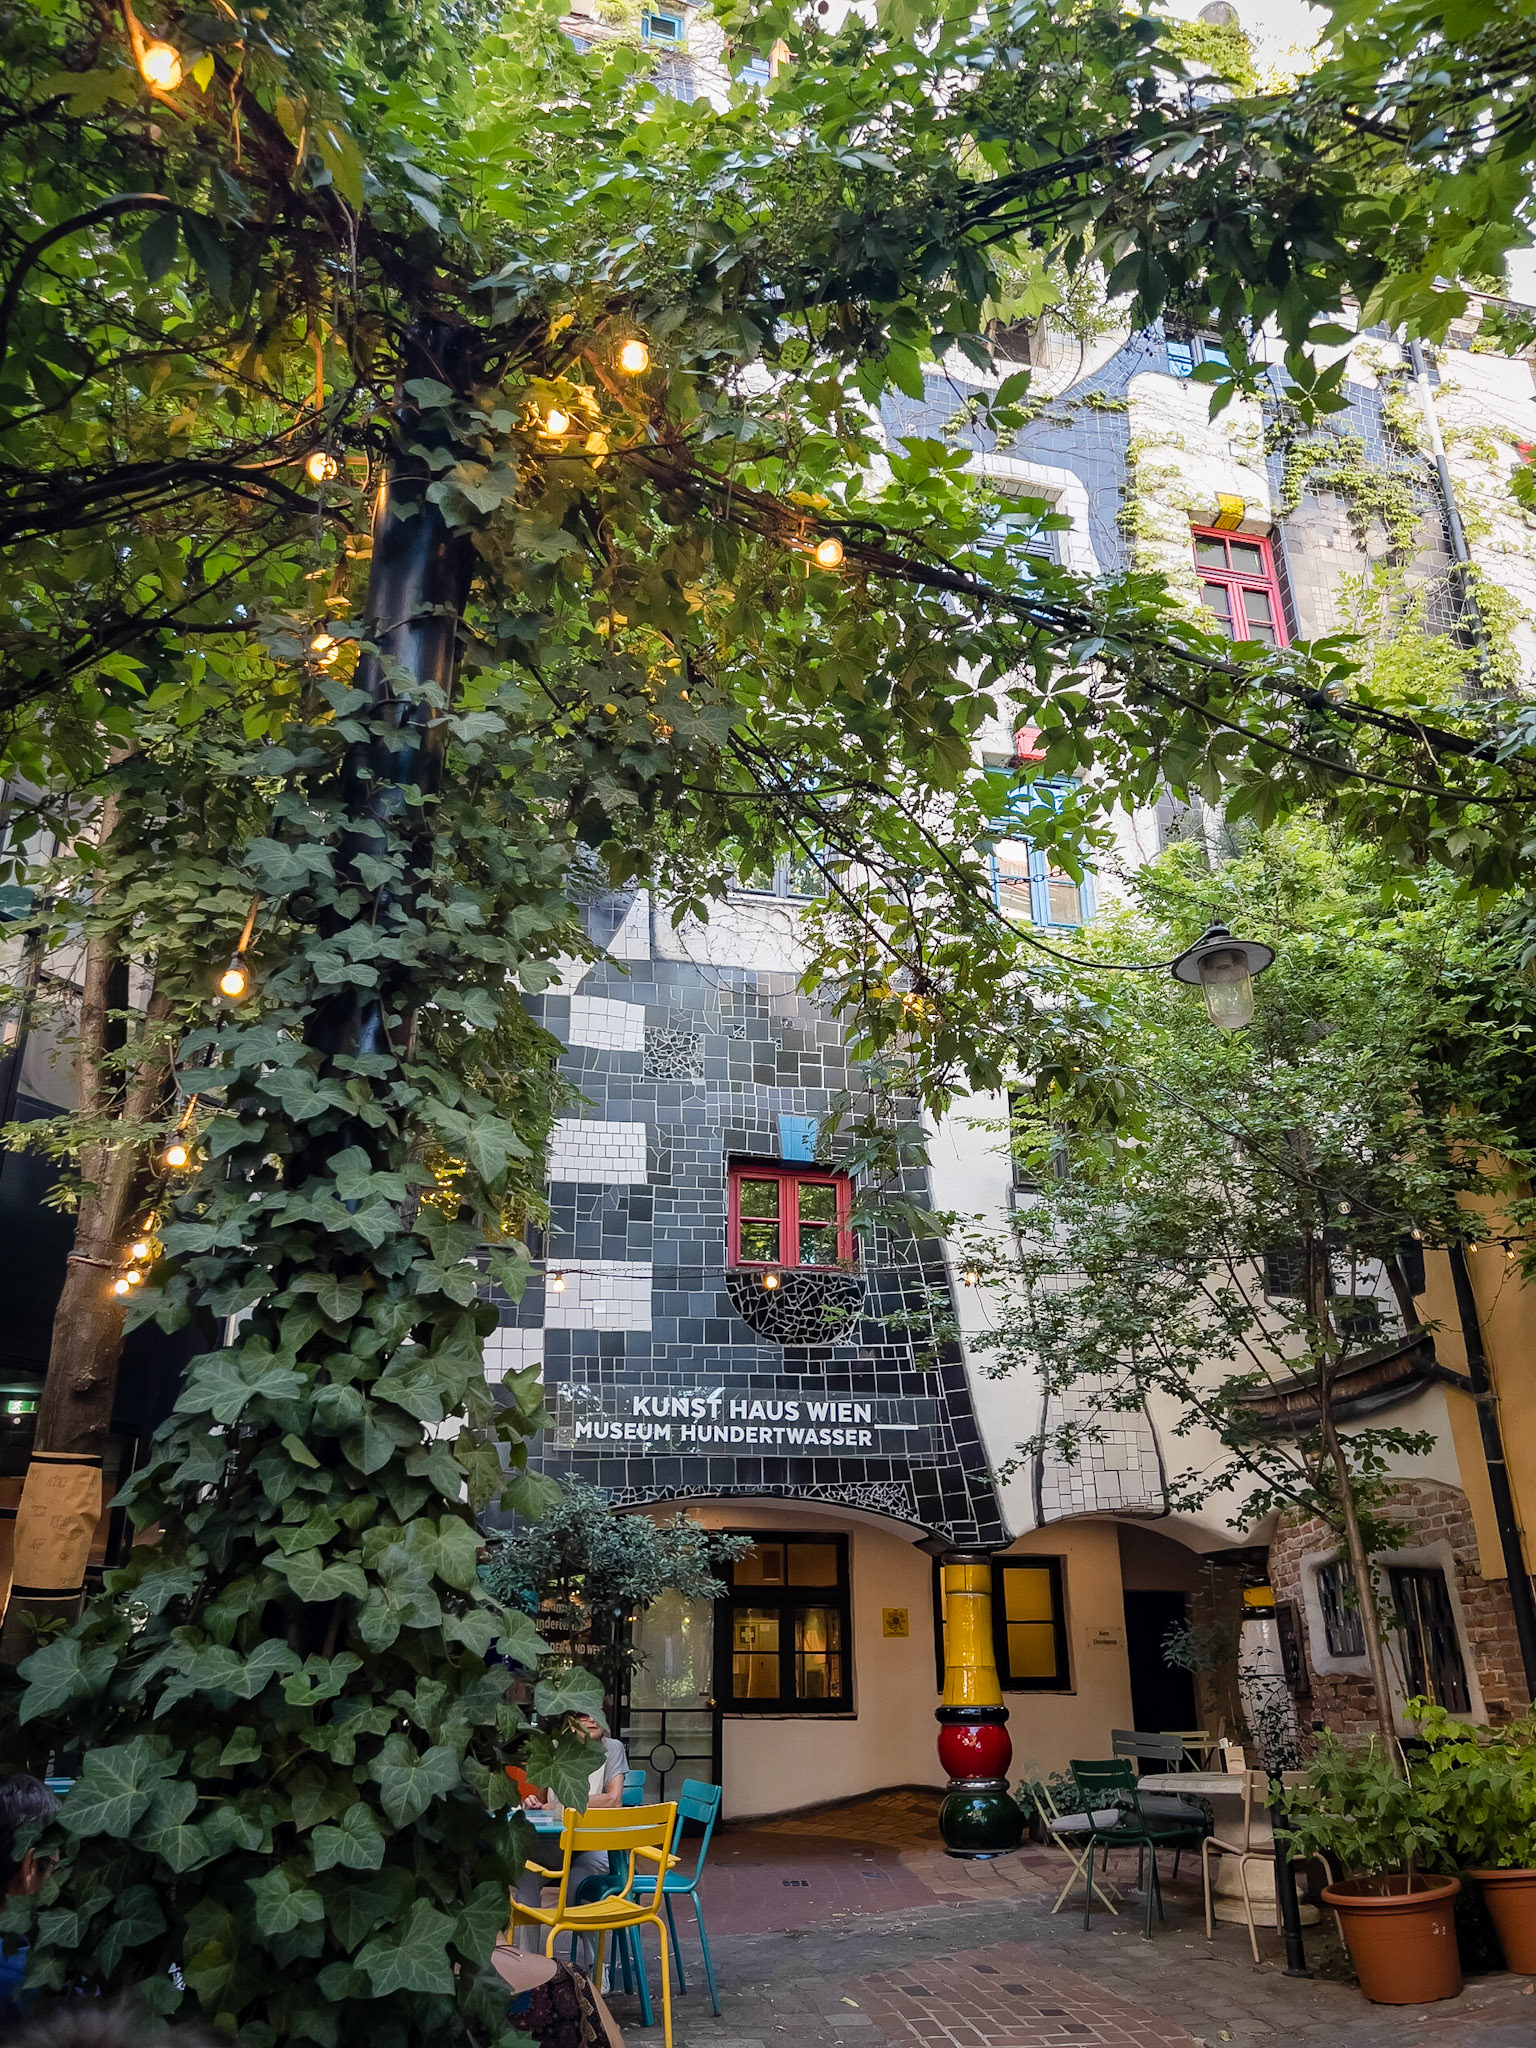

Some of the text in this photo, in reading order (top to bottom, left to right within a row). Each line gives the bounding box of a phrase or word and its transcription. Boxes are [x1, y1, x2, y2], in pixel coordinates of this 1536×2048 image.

[632, 1395, 872, 1424] KUNST HAUS WIEN
[574, 1420, 873, 1447] MUSEUM HUNDERTWASSER
